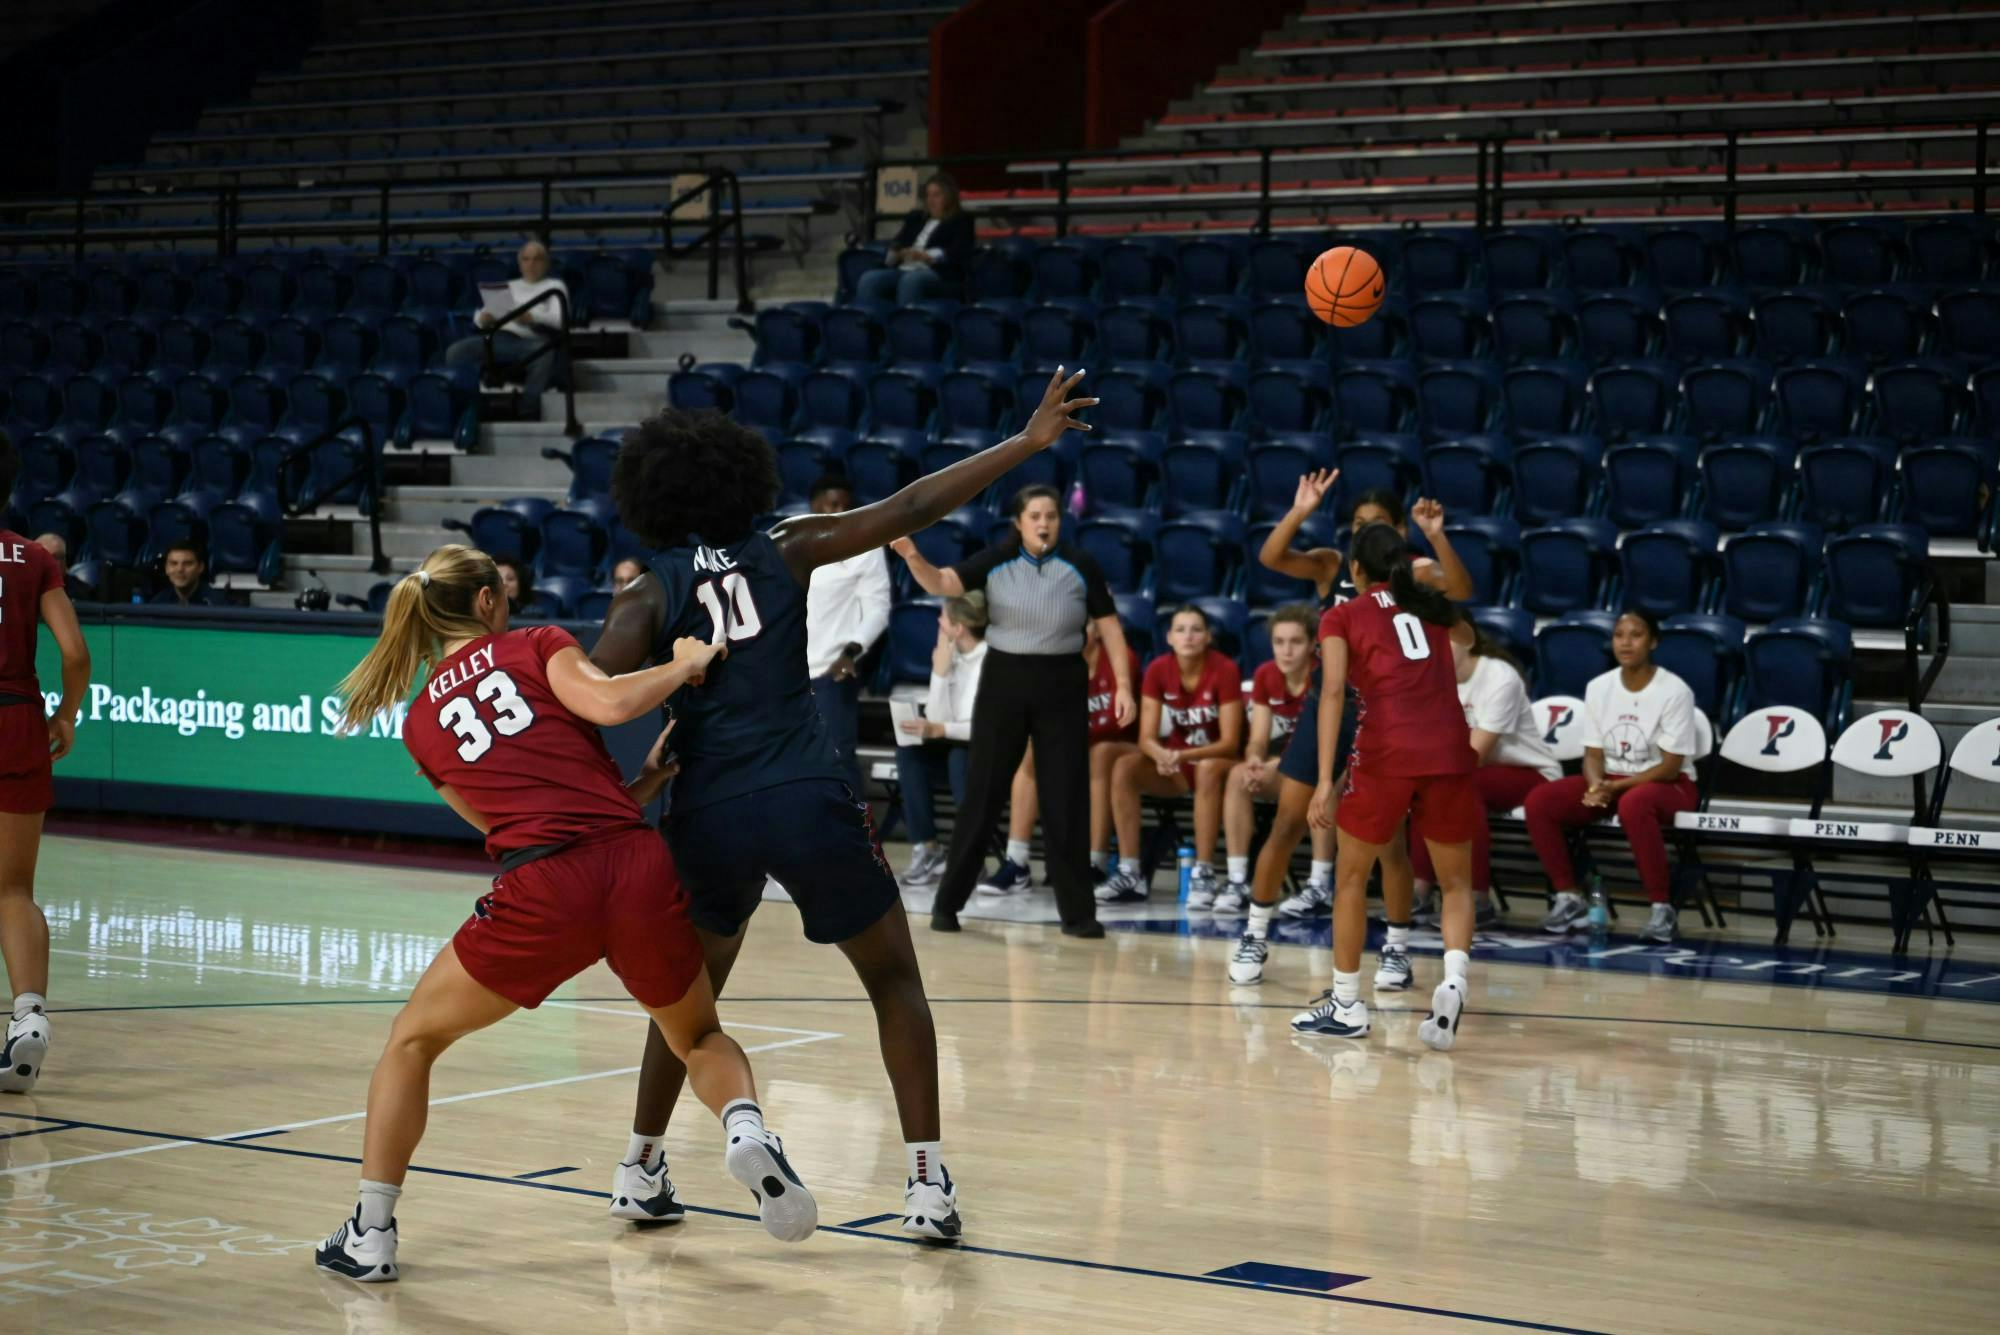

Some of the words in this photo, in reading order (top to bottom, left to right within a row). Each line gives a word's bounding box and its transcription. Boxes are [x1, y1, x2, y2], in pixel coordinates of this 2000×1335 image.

[884, 180, 912, 197] 104
[696, 572, 763, 646] 10
[1392, 611, 1431, 661] 0
[428, 643, 494, 704] KELLEY
[89, 683, 245, 740] Packaging
[252, 694, 312, 734] and
[437, 668, 536, 764] 33
[1543, 705, 1574, 744] P
[1761, 715, 1795, 755] P
[1873, 719, 1908, 760] P
[1698, 816, 1740, 830] PENN
[1815, 823, 1859, 837] PENN
[1934, 831, 1980, 846] PENN
